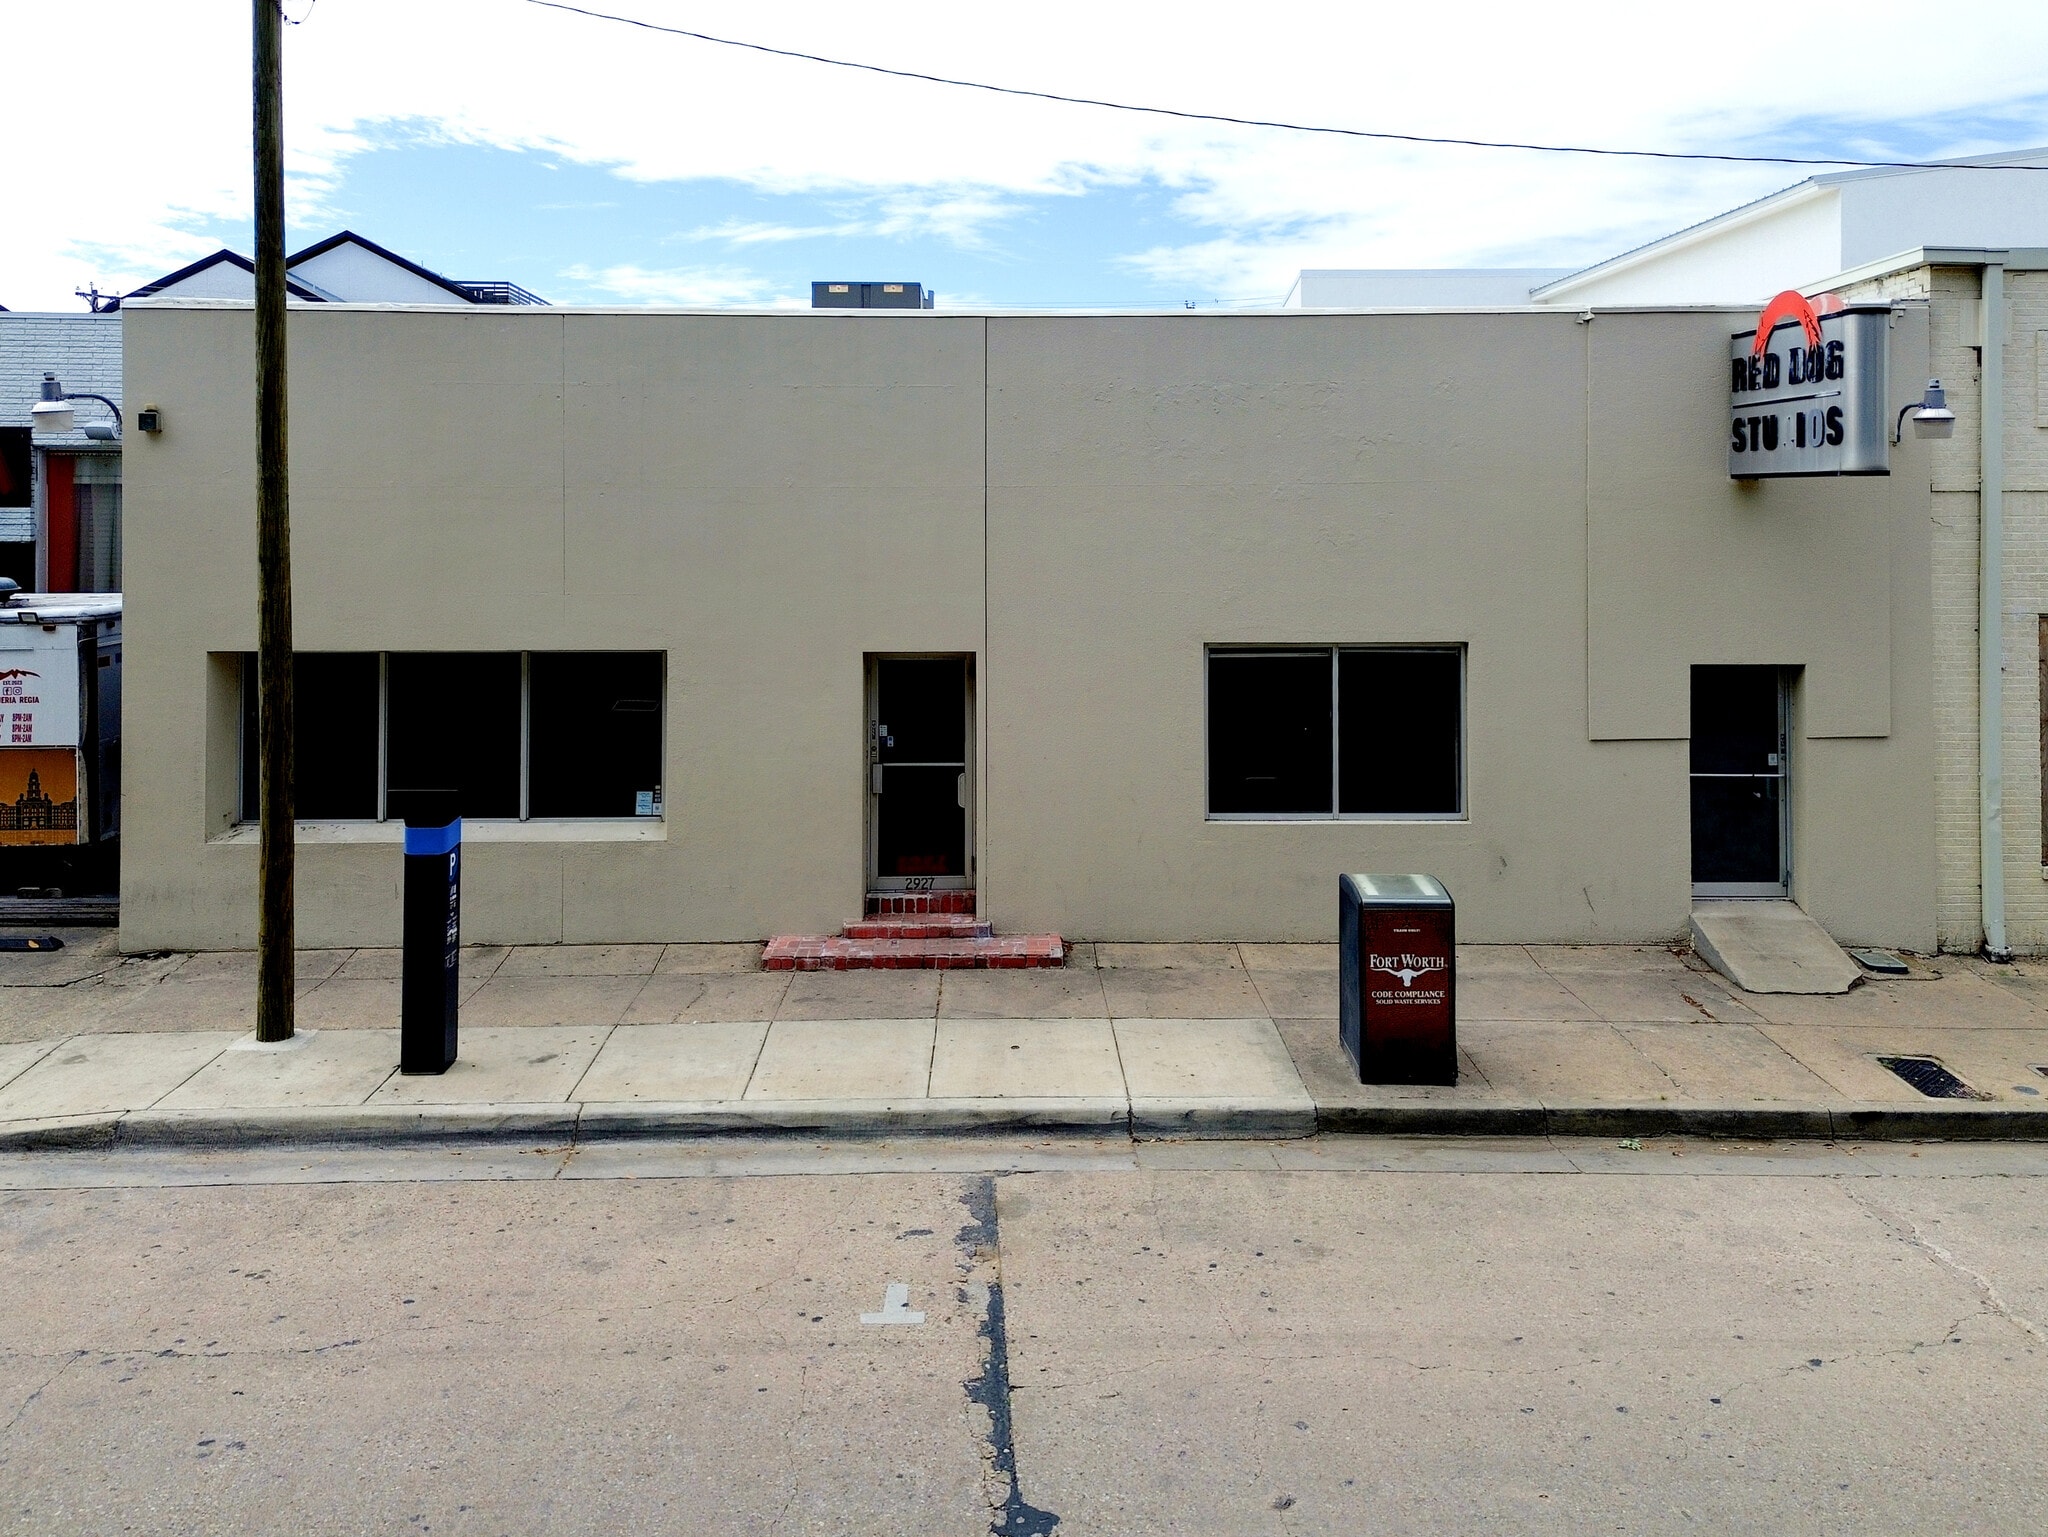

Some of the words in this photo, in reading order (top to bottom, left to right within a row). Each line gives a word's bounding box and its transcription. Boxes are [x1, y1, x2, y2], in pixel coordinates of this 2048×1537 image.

[1732, 352, 1780, 393] RED
[1788, 340, 1844, 385] DOG
[1731, 405, 1844, 453] STUIOS
[905, 877, 935, 890] 2927
[1370, 954, 1399, 967] FORT
[1401, 954, 1444, 967] WORTH
